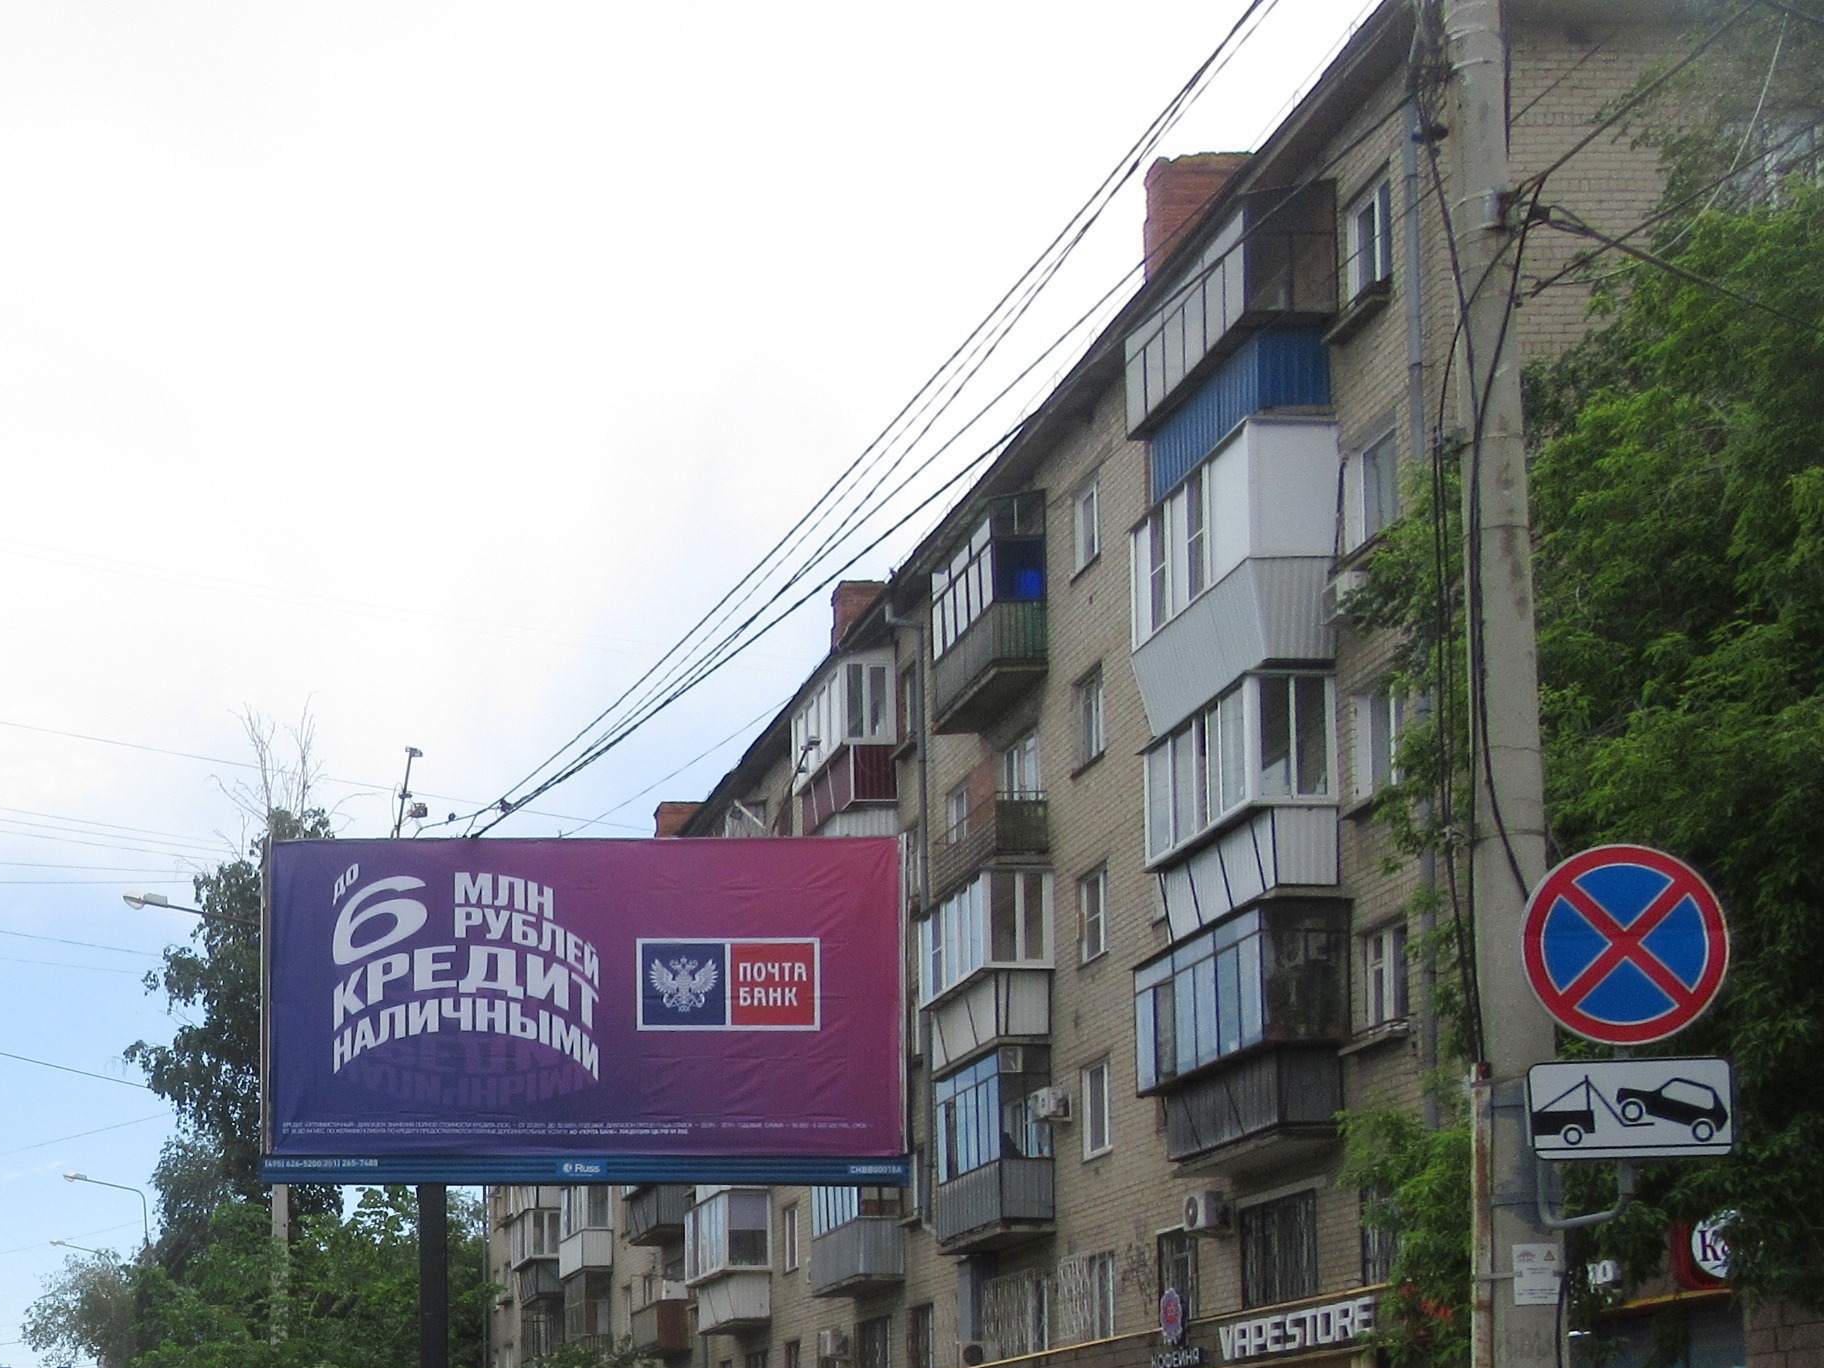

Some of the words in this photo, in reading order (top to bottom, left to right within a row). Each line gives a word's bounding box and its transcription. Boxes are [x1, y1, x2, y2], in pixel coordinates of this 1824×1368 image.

[332, 863, 359, 906] ДО
[454, 872, 554, 920] МЛН
[332, 876, 427, 965] 6
[454, 907, 599, 989] РУБЛЕЙ
[333, 945, 599, 1032] КРЕДИТ
[738, 962, 807, 981] ПОЧТА
[739, 987, 798, 1007] БАНК
[333, 997, 599, 1081] НАЛИЧНЫМИ
[574, 1163, 600, 1173] Russ
[1218, 1296, 1376, 1360] VAPESTORE
